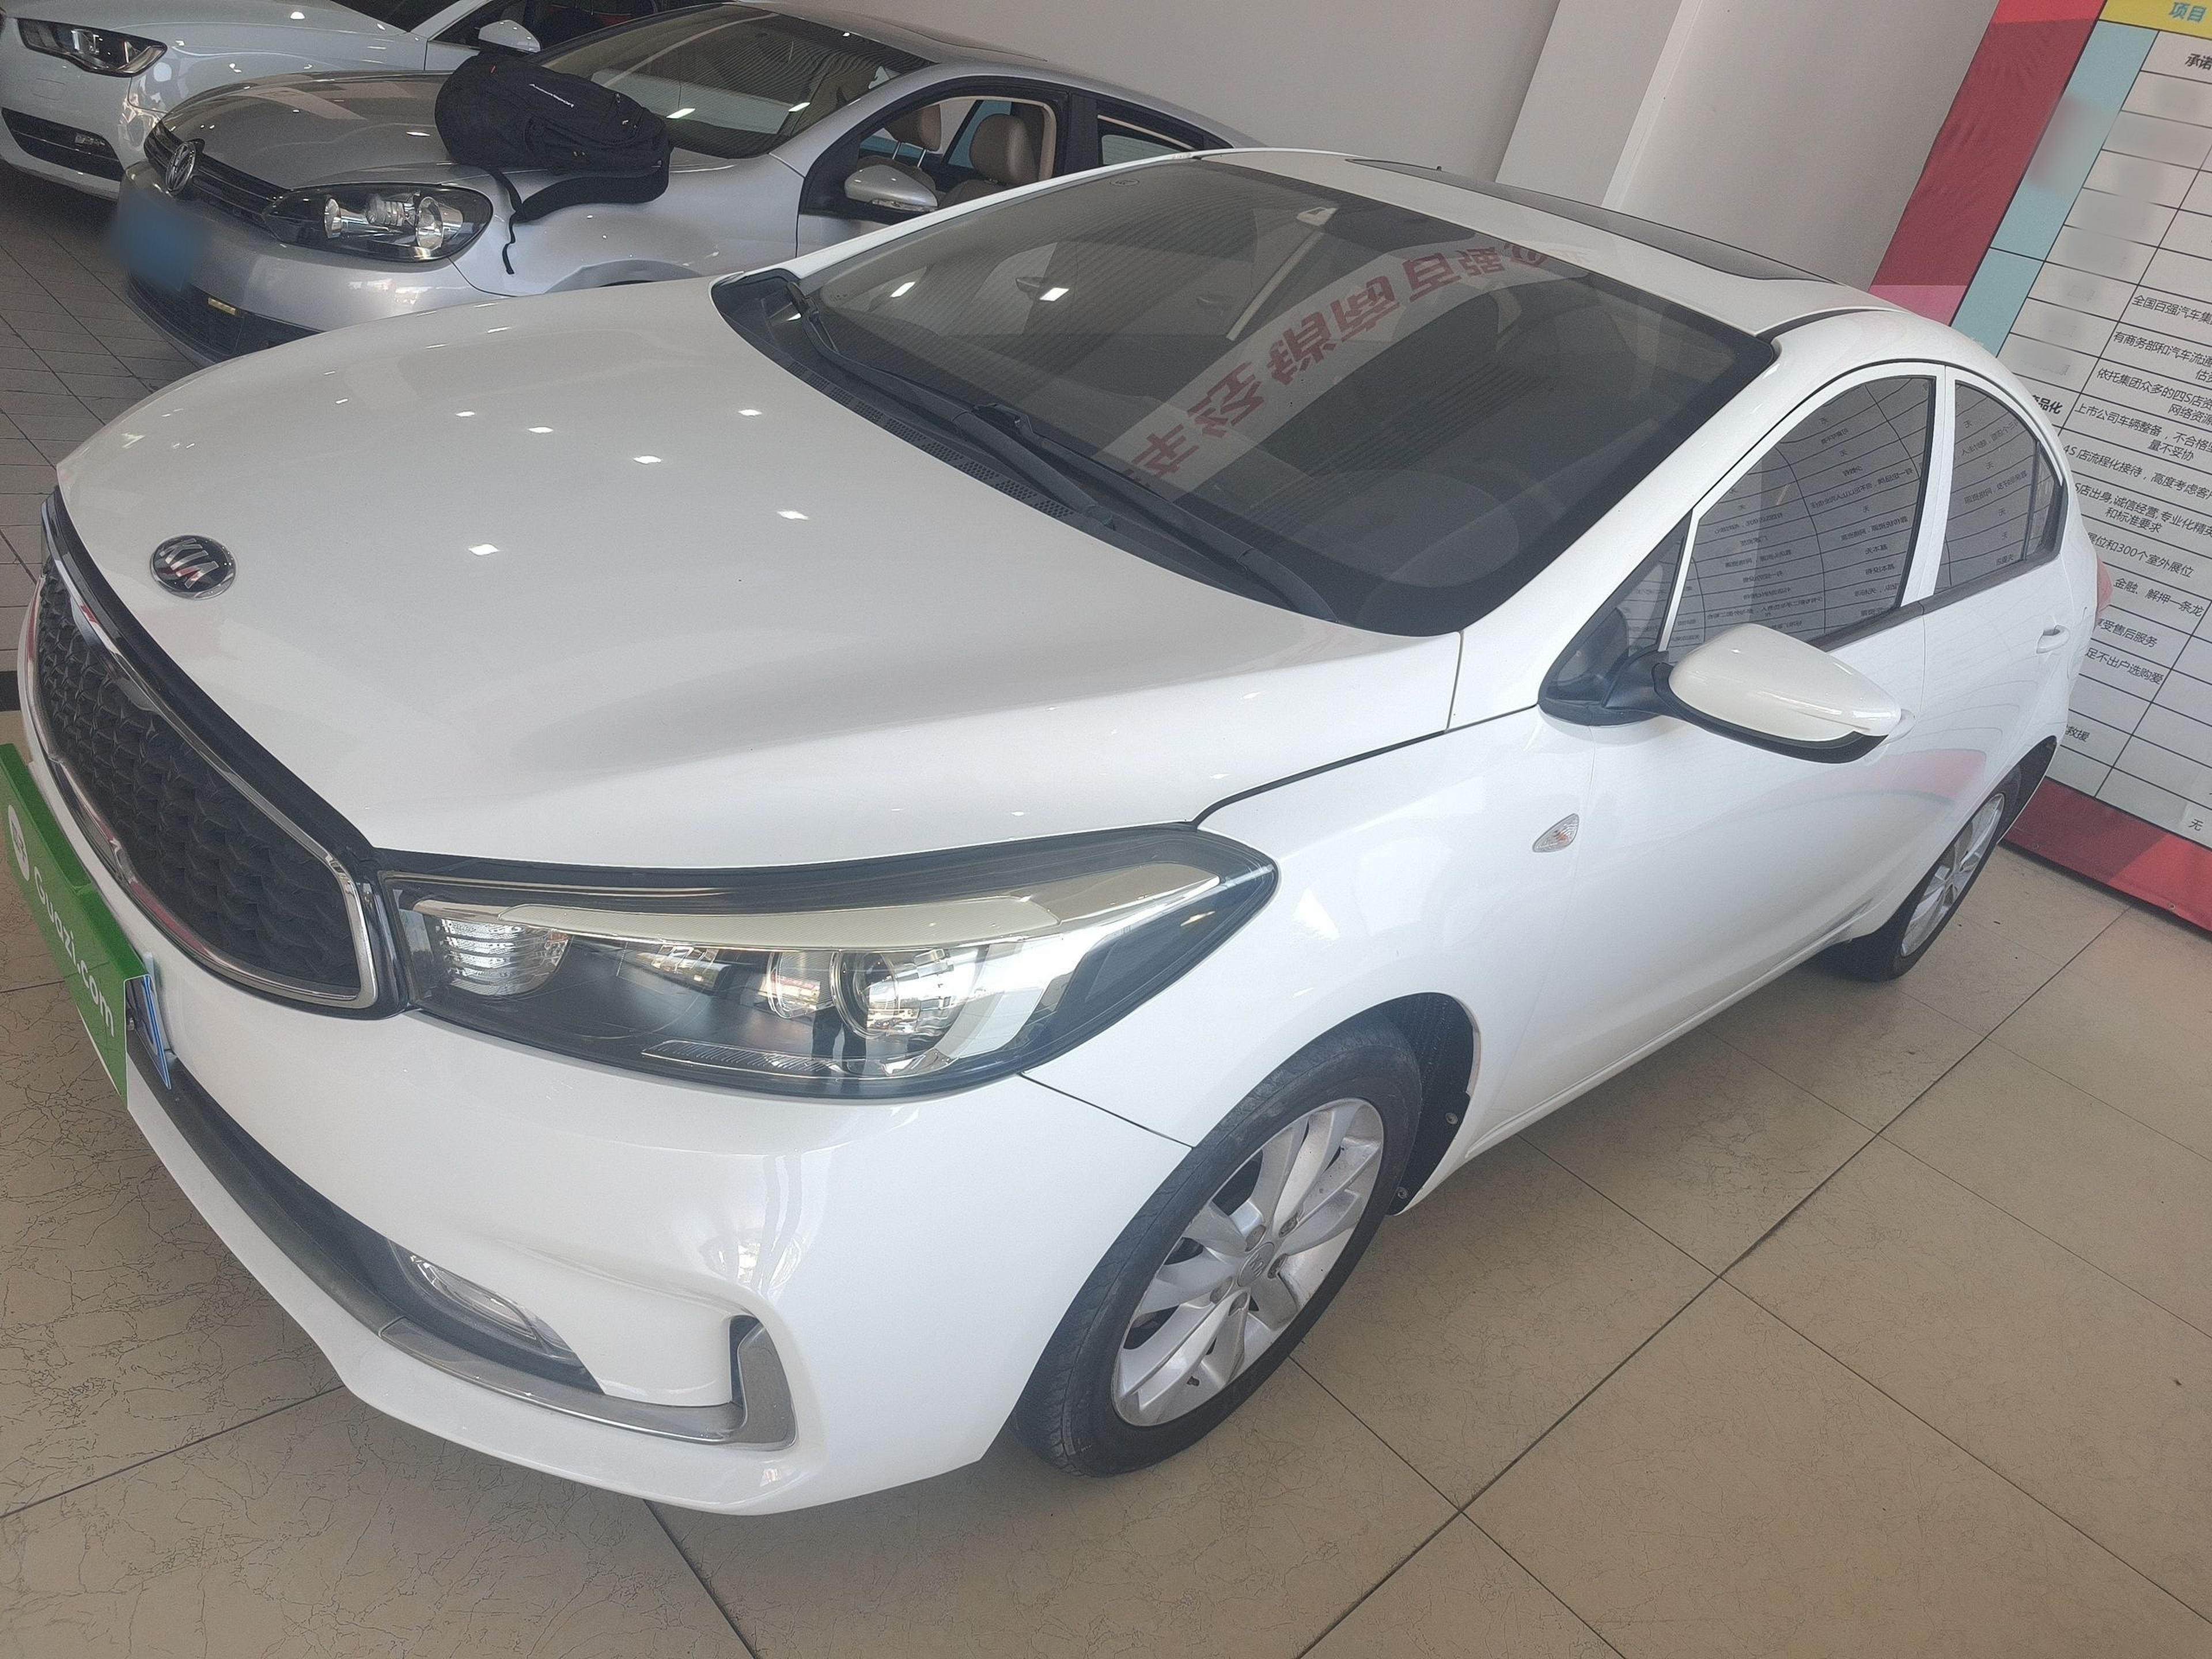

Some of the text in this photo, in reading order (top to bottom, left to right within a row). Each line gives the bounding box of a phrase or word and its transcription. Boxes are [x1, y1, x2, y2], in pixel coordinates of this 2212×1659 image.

[2169, 2, 2207, 22] 项目
[2184, 52, 2212, 70] 承诺
[2131, 294, 2212, 326] 全国百强汽车集
[2074, 403, 2212, 453] 上市公司车辆整备，不合格
[2147, 439, 2195, 461] 量不妥协
[2105, 507, 2163, 534] 和标准要求
[2113, 578, 2205, 618] 金融、解押一条龙
[2065, 724, 2090, 743] 救援
[2188, 818, 2204, 831] 无
[34, 866, 115, 1037] Guazi.com
